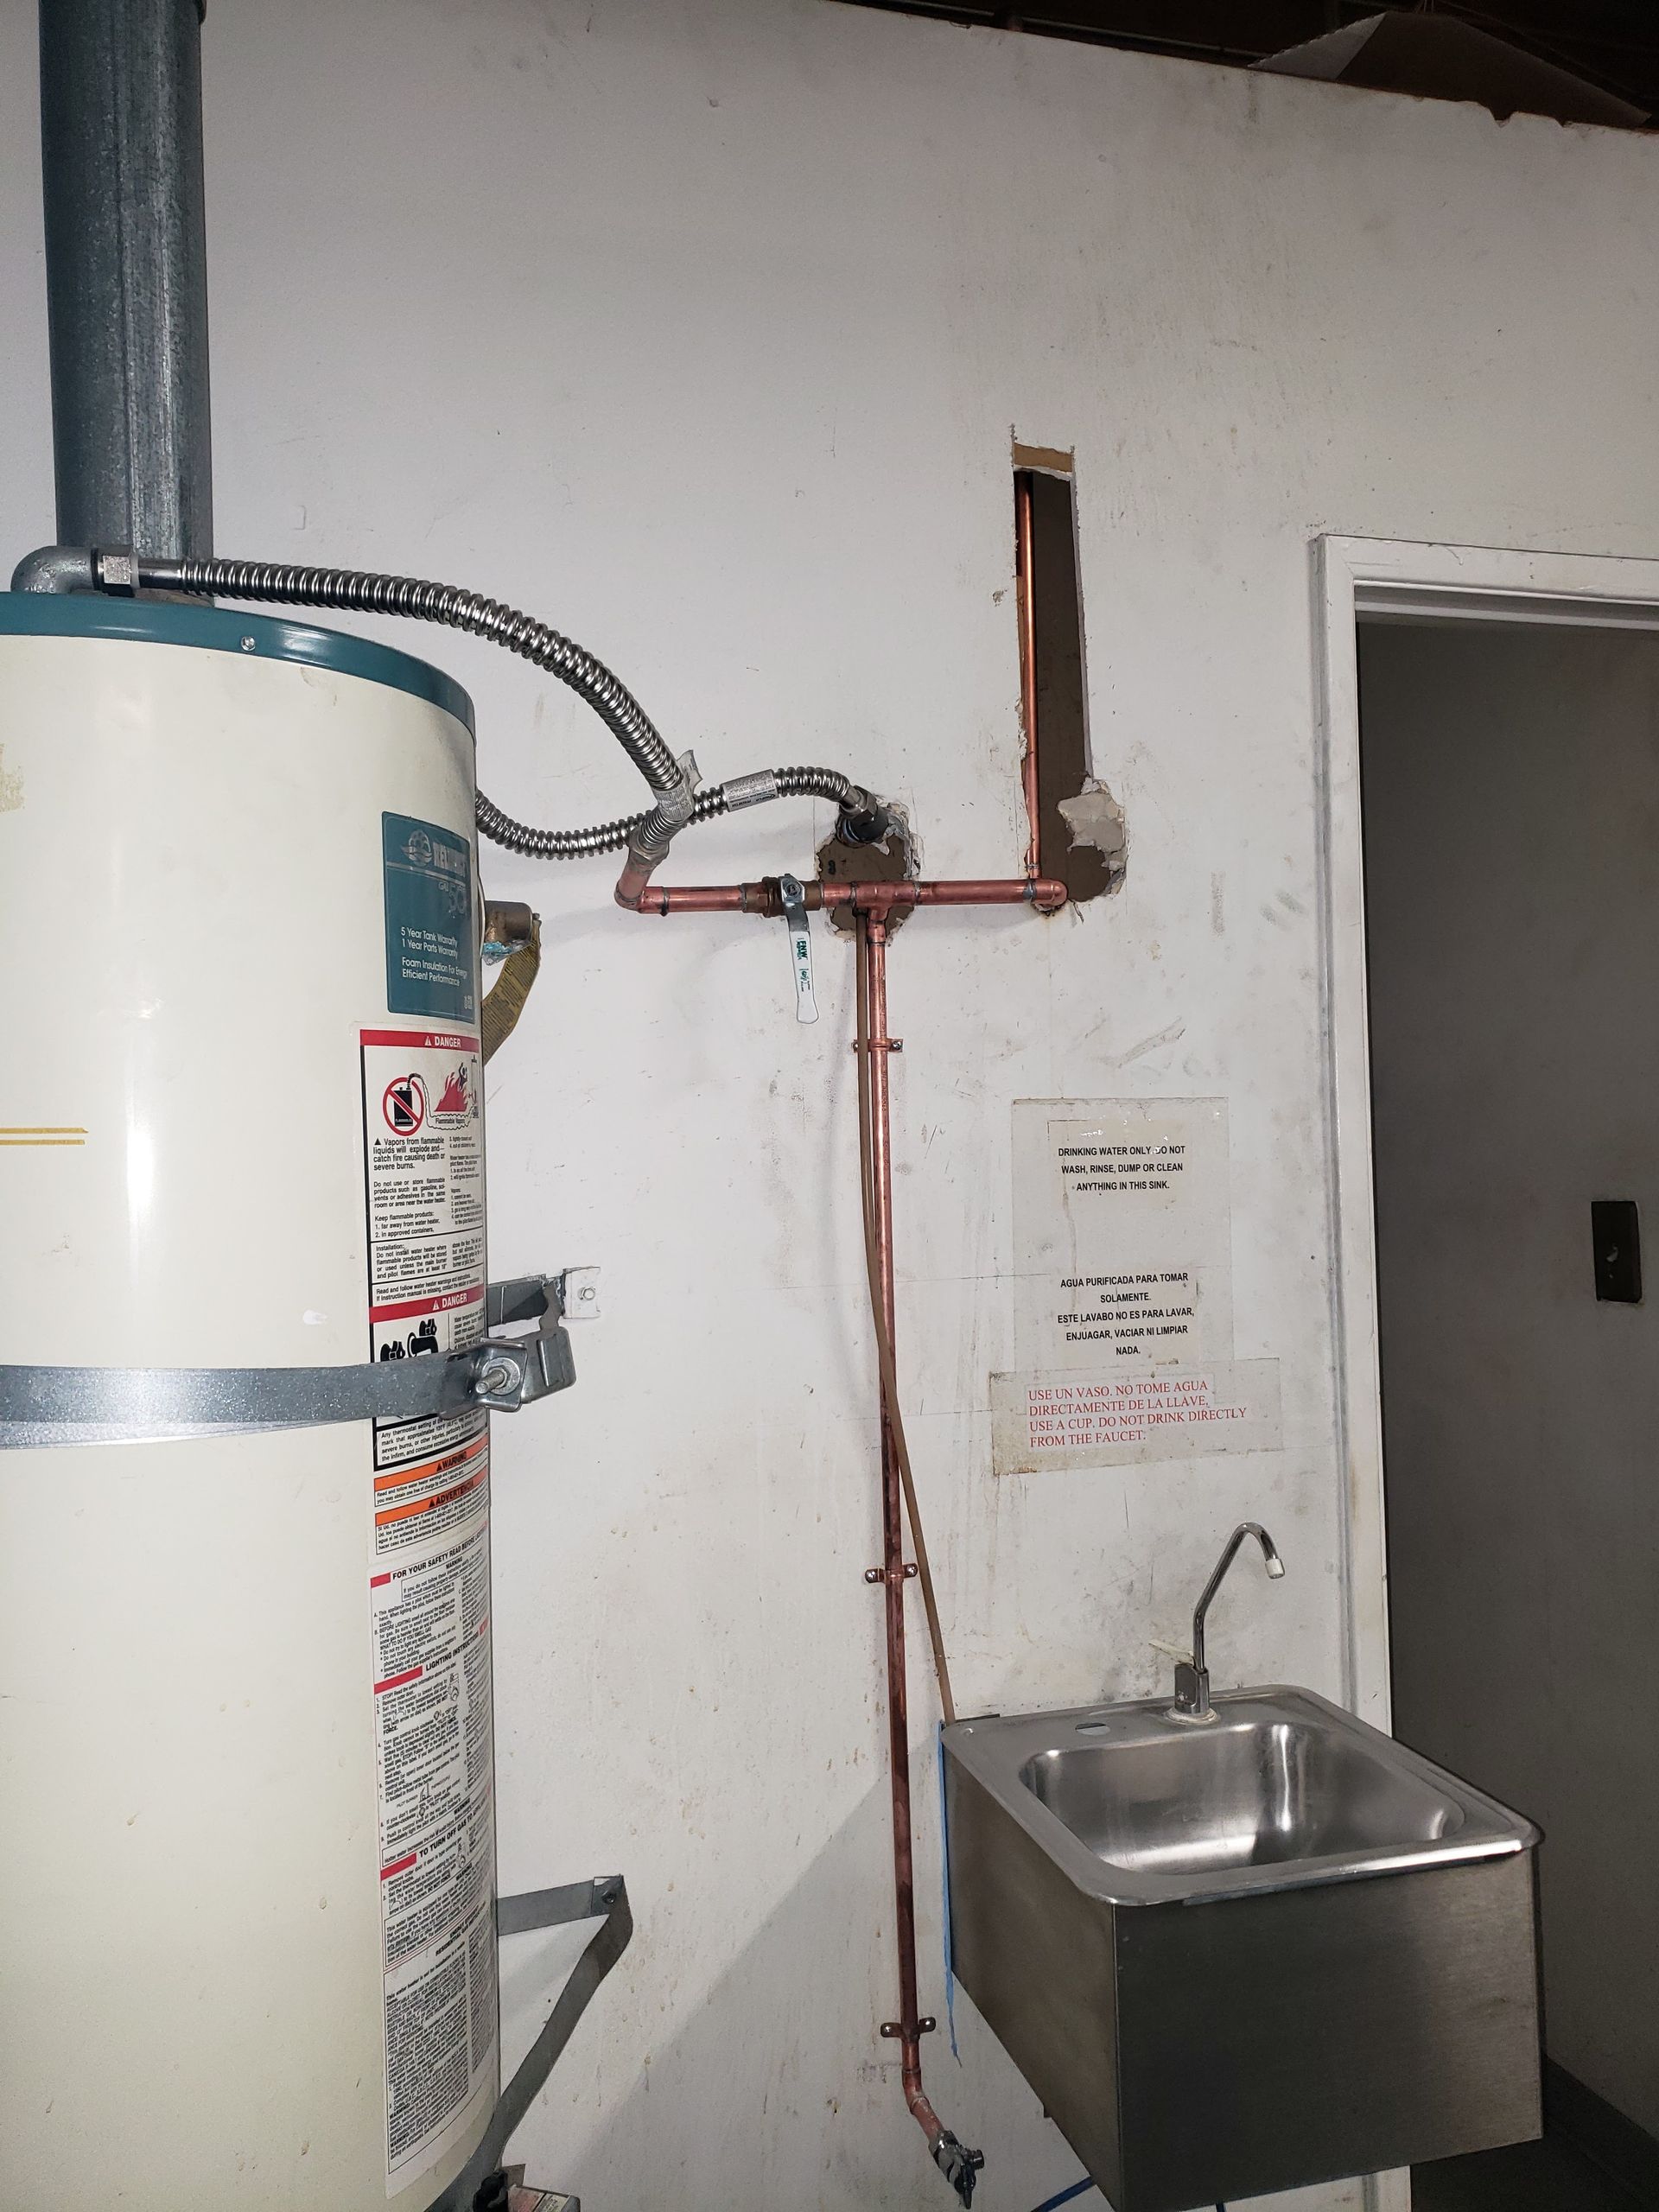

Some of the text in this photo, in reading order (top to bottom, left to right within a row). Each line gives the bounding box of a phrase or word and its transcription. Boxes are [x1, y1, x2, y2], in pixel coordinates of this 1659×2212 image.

[401, 927, 405, 936] 5
[407, 927, 422, 938] Year
[423, 931, 436, 941] Tank
[403, 938, 405, 947] 1
[408, 939, 422, 950] Year
[423, 942, 437, 952] Parts
[403, 957, 421, 968] Foam
[423, 960, 448, 972] Insulation
[403, 969, 460, 986] Efficient Performance
[435, 1036, 461, 1047] DANGER
[410, 1145, 429, 1154] explode
[1058, 1147, 1097, 1156] DRINKING
[1099, 1147, 1128, 1155] WATER
[1061, 1165, 1088, 1174] WASH,
[1090, 1165, 1116, 1173] RINSE,
[1143, 1163, 1154, 1172] OR
[1077, 1182, 1117, 1191] ANYTHING
[1129, 1181, 1147, 1190] THIS
[1060, 1273, 1188, 1287] AGUA PURIFICADA PARA TOMAR
[442, 1293, 467, 1308] DANGER
[1101, 1293, 1151, 1303] SOLAMENTE.
[1058, 1307, 1194, 1323] ESTE LAVABO NO ES PARA LAVAR,
[1066, 1325, 1188, 1340] ENJUAGAR, VACIAR NI LIMPIAR
[1116, 1346, 1141, 1355] NADA.
[1028, 1380, 1208, 1401] USE UN VASO. NO TOME AGUA
[1030, 1401, 1125, 1416] DIRECTAMENTE
[1128, 1400, 1144, 1410] DE
[1147, 1397, 1163, 1408] LA
[1030, 1408, 1247, 1432] USE A CUP. DO NOT DRINK DIRECTLY
[393, 1426, 416, 1434] thermostat
[1030, 1430, 1146, 1447] FROM THE FAUCET.
[392, 1570, 407, 1580] FOR
[409, 1561, 427, 1573] YOUR
[428, 1554, 448, 1567] SAFETY
[449, 1548, 461, 1557] READ
[446, 1556, 463, 1569] WARNING
[426, 1652, 451, 1671] LIGHTING
[419, 1848, 428, 1858] TO
[429, 1836, 446, 1851] TURN
[447, 1827, 456, 1840] OFF
[457, 1821, 466, 1831] GAS
